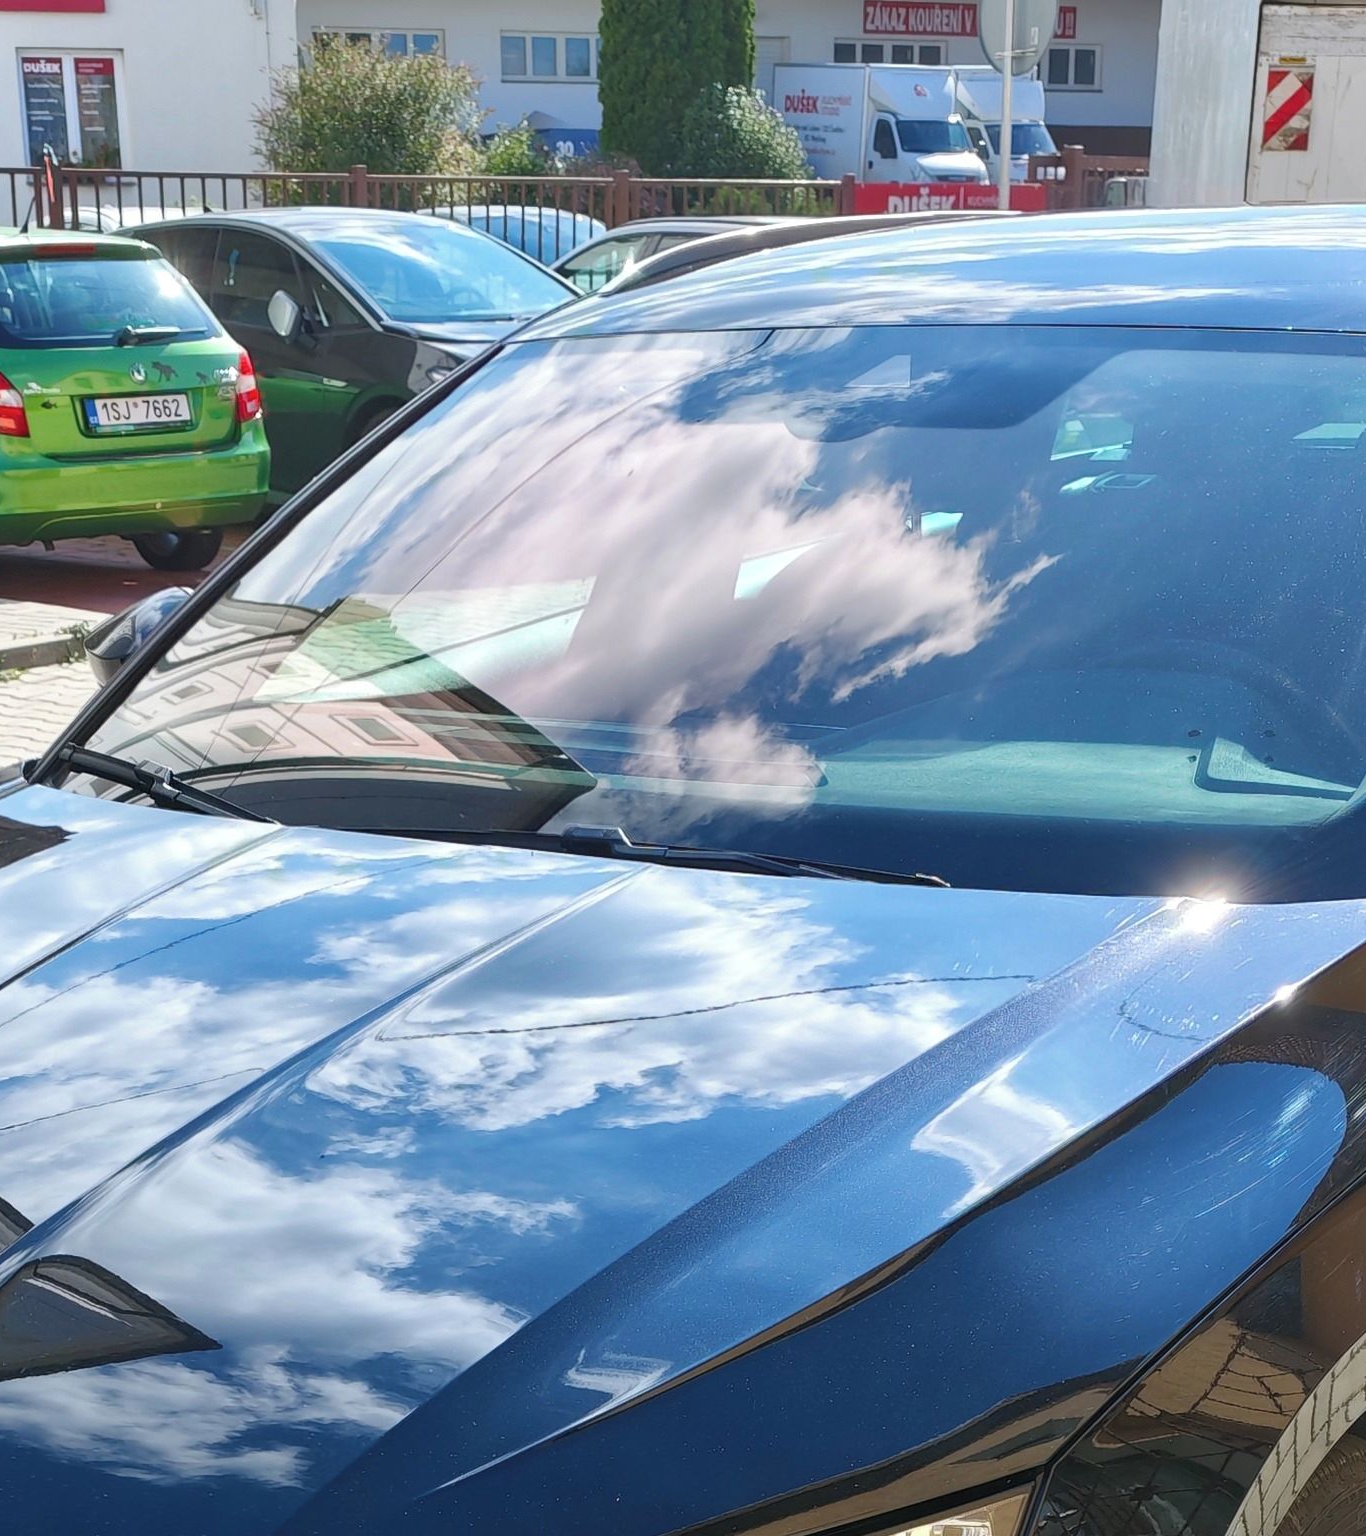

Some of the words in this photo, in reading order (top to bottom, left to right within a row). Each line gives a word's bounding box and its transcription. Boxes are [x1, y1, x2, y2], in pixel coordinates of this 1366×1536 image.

[866, 2, 906, 31] ZÁKAZ
[908, 5, 963, 33] KOUŘENÍ
[964, 9, 974, 33] V
[23, 60, 61, 74] DUŠEK
[785, 89, 819, 114] DUŠEK
[102, 401, 131, 422] 1SJ
[143, 399, 183, 419] 7662
